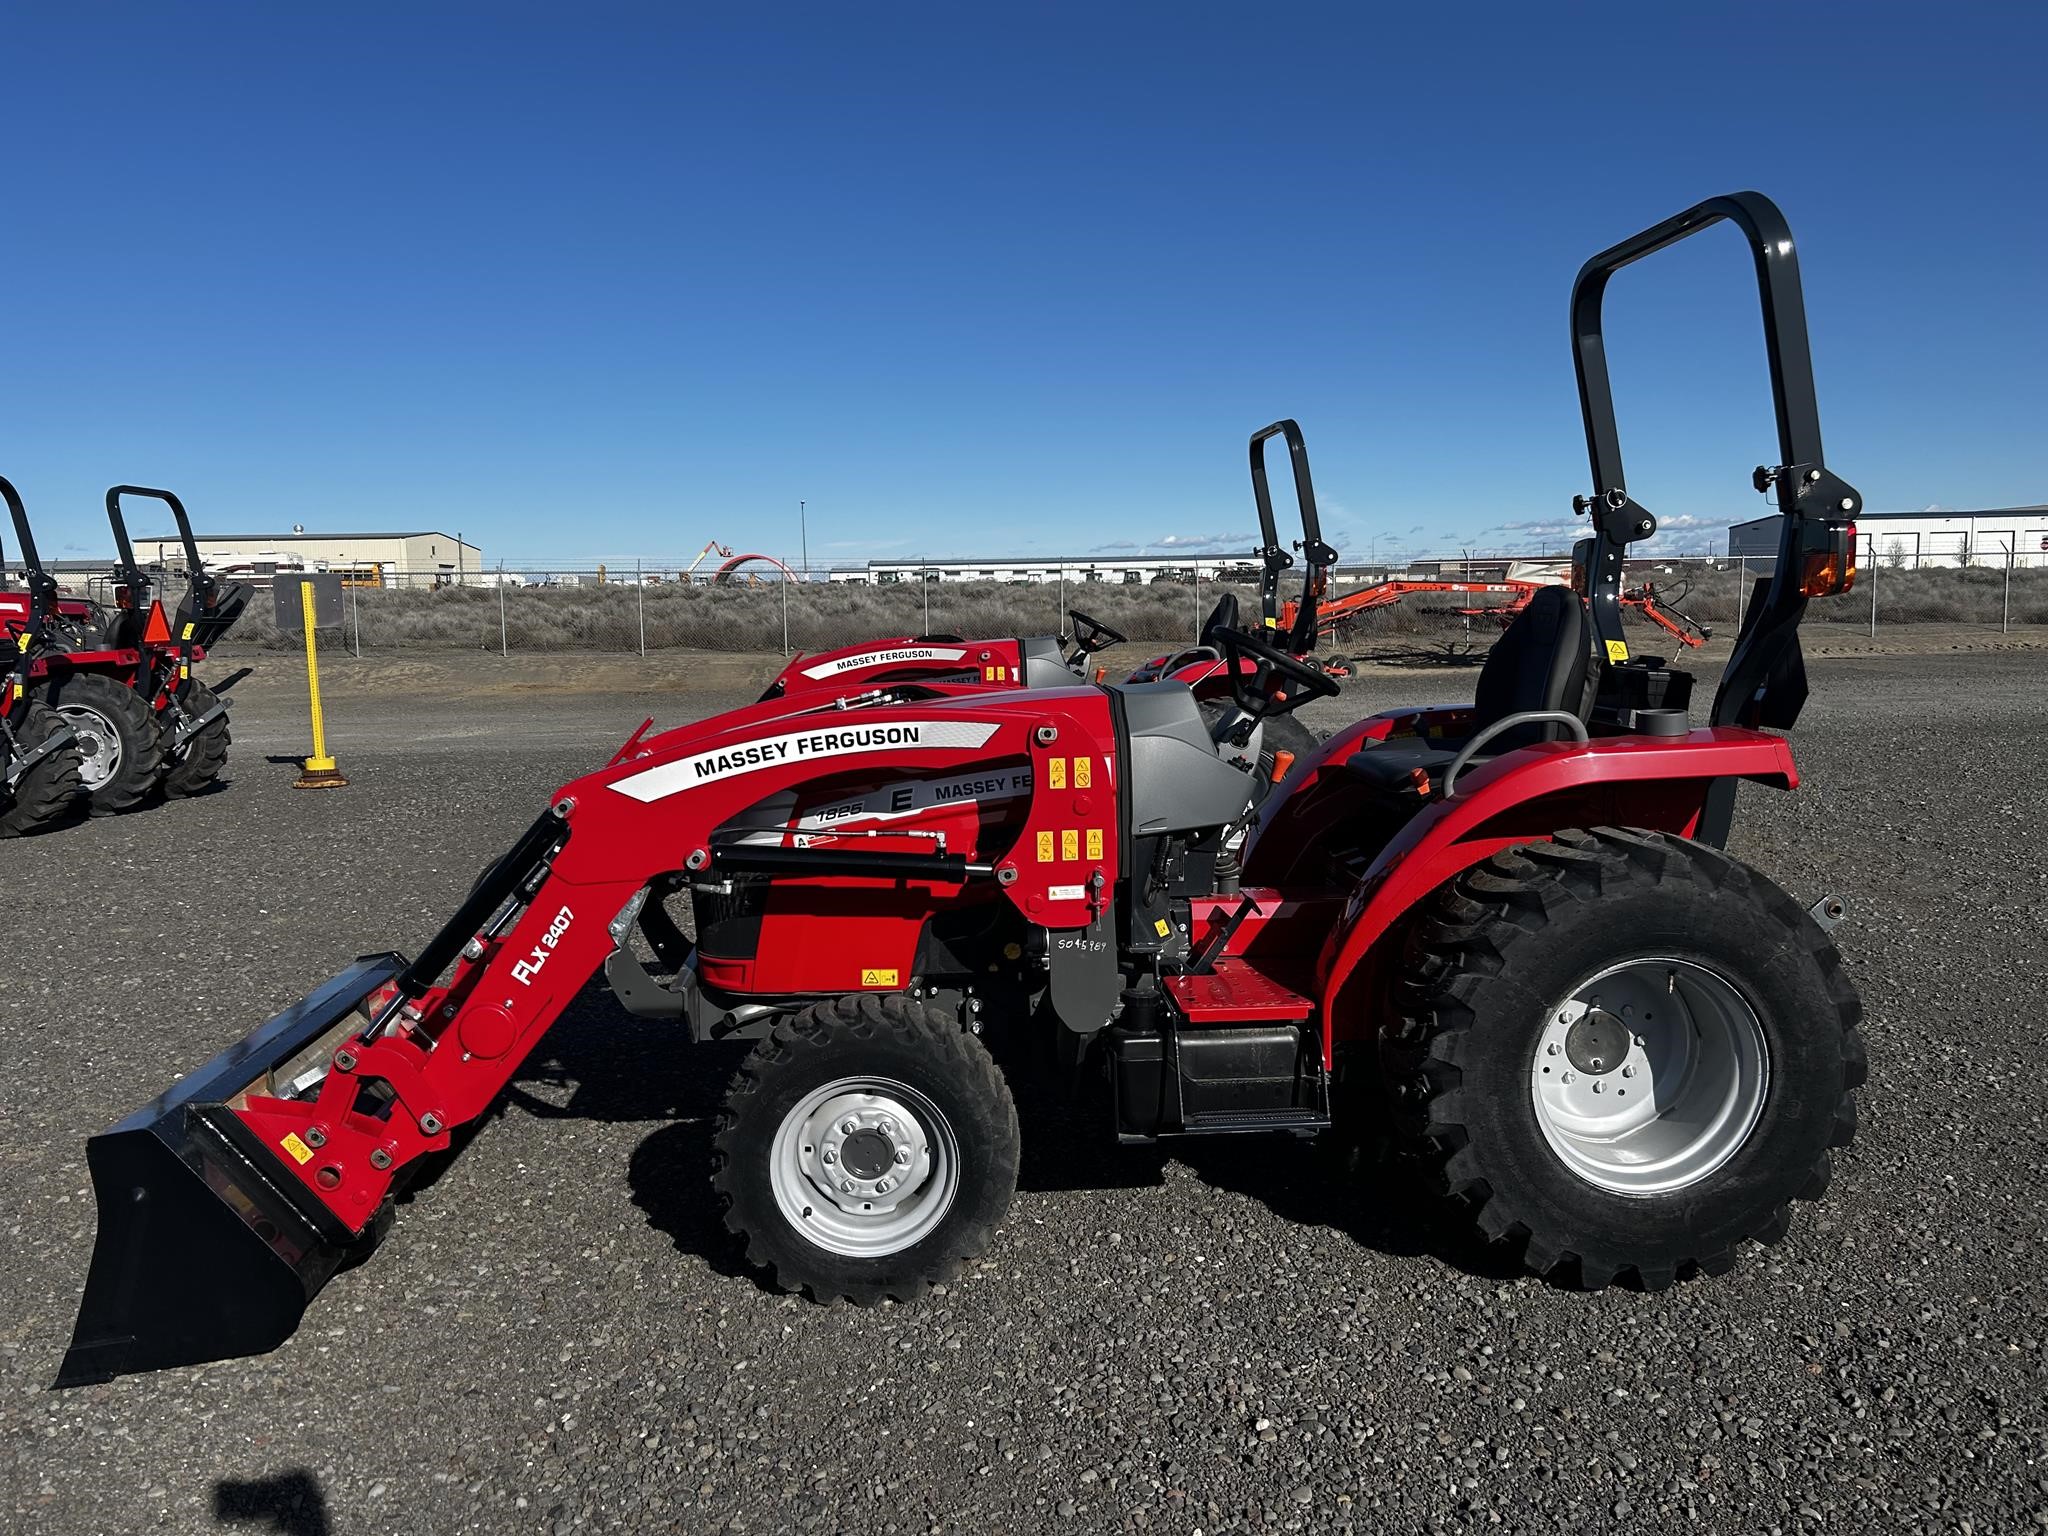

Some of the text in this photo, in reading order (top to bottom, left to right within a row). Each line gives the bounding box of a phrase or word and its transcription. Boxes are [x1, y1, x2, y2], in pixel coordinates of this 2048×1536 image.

[837, 650, 933, 670] MASSEY FERGUSON
[694, 727, 919, 778] MASSEY FERGUSON
[816, 788, 914, 822] 1825 E
[935, 777, 1006, 800] MASSEY
[510, 905, 574, 986] FLX 2407
